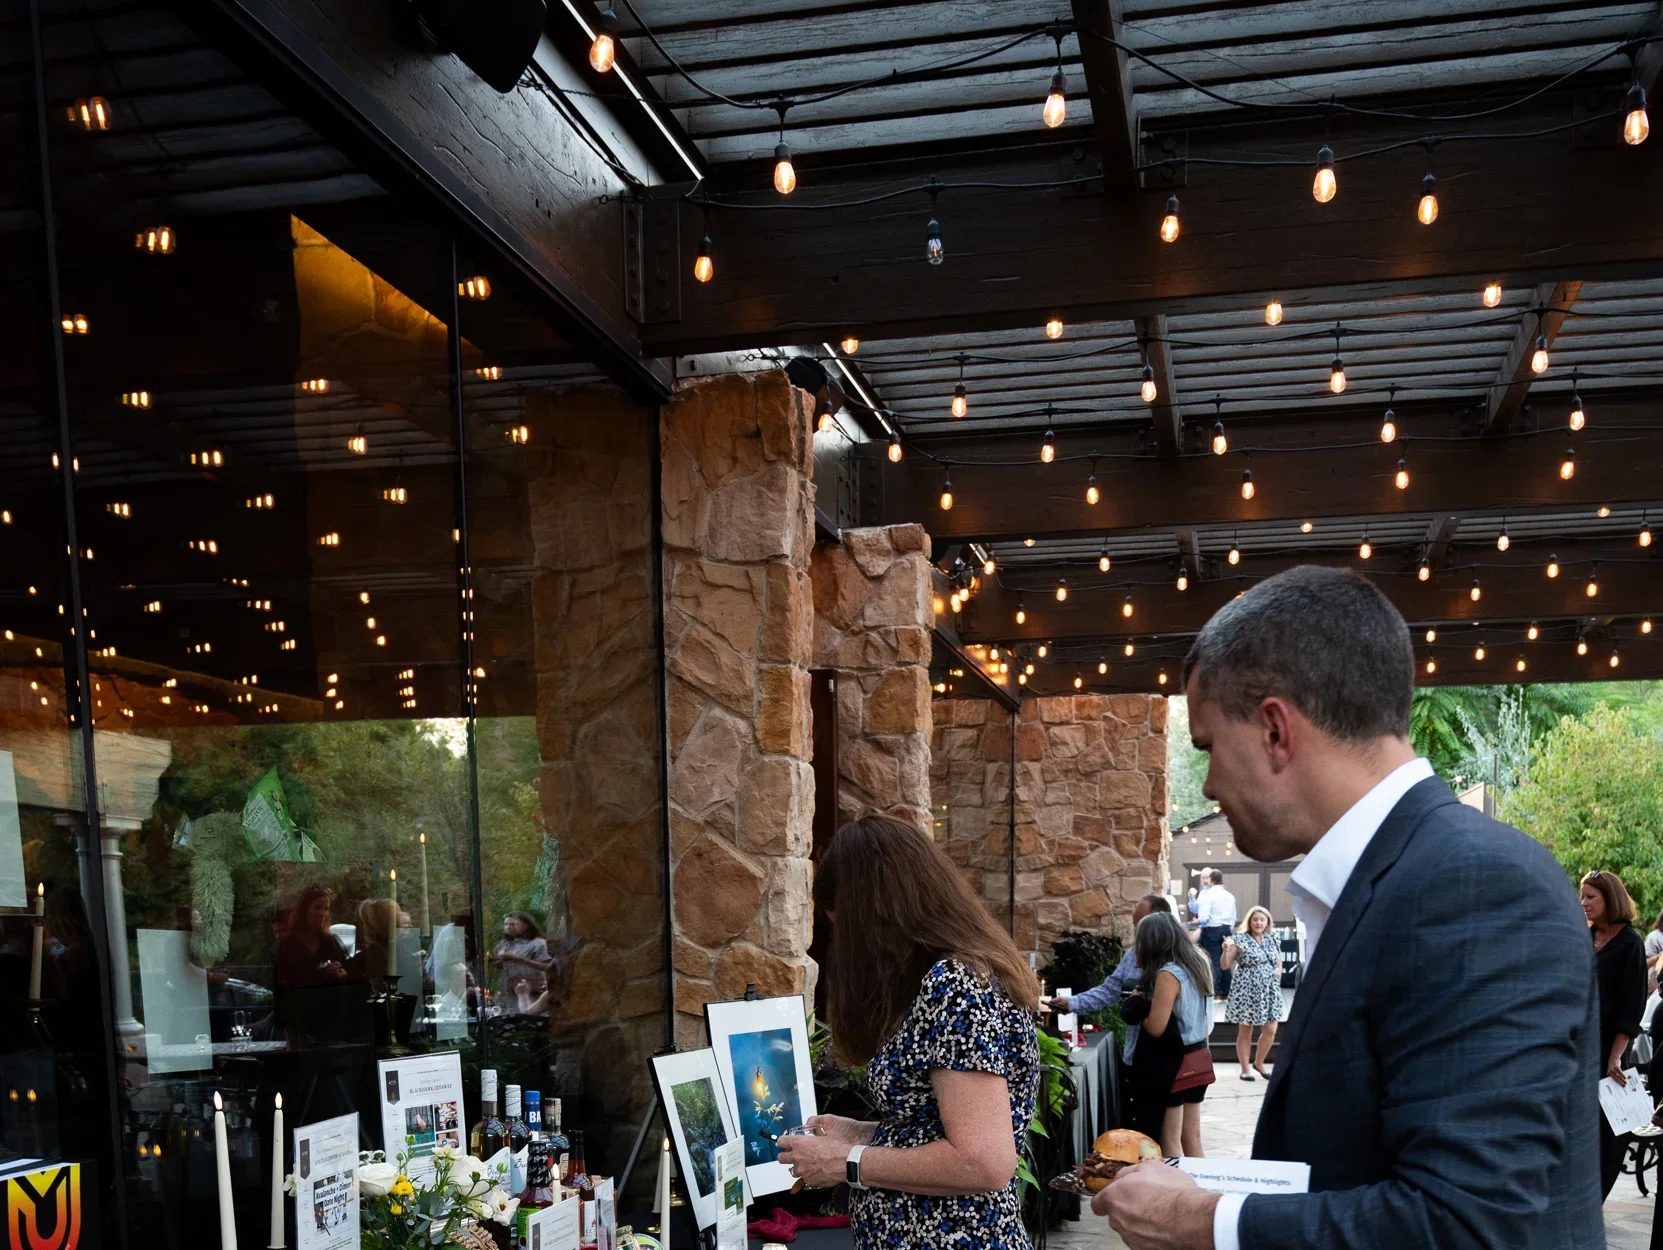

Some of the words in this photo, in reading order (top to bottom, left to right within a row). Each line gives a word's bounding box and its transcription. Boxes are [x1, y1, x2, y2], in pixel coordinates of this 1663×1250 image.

[409, 1086, 434, 1094] BLACKHAWK
[1200, 1173, 1226, 1182] Evening's
[1227, 1175, 1253, 1183] Schedule
[1260, 1178, 1291, 1186] Highlights
[315, 1186, 336, 1200] Avalanche
[324, 1198, 334, 1207] Date
[334, 1193, 345, 1204] Night
